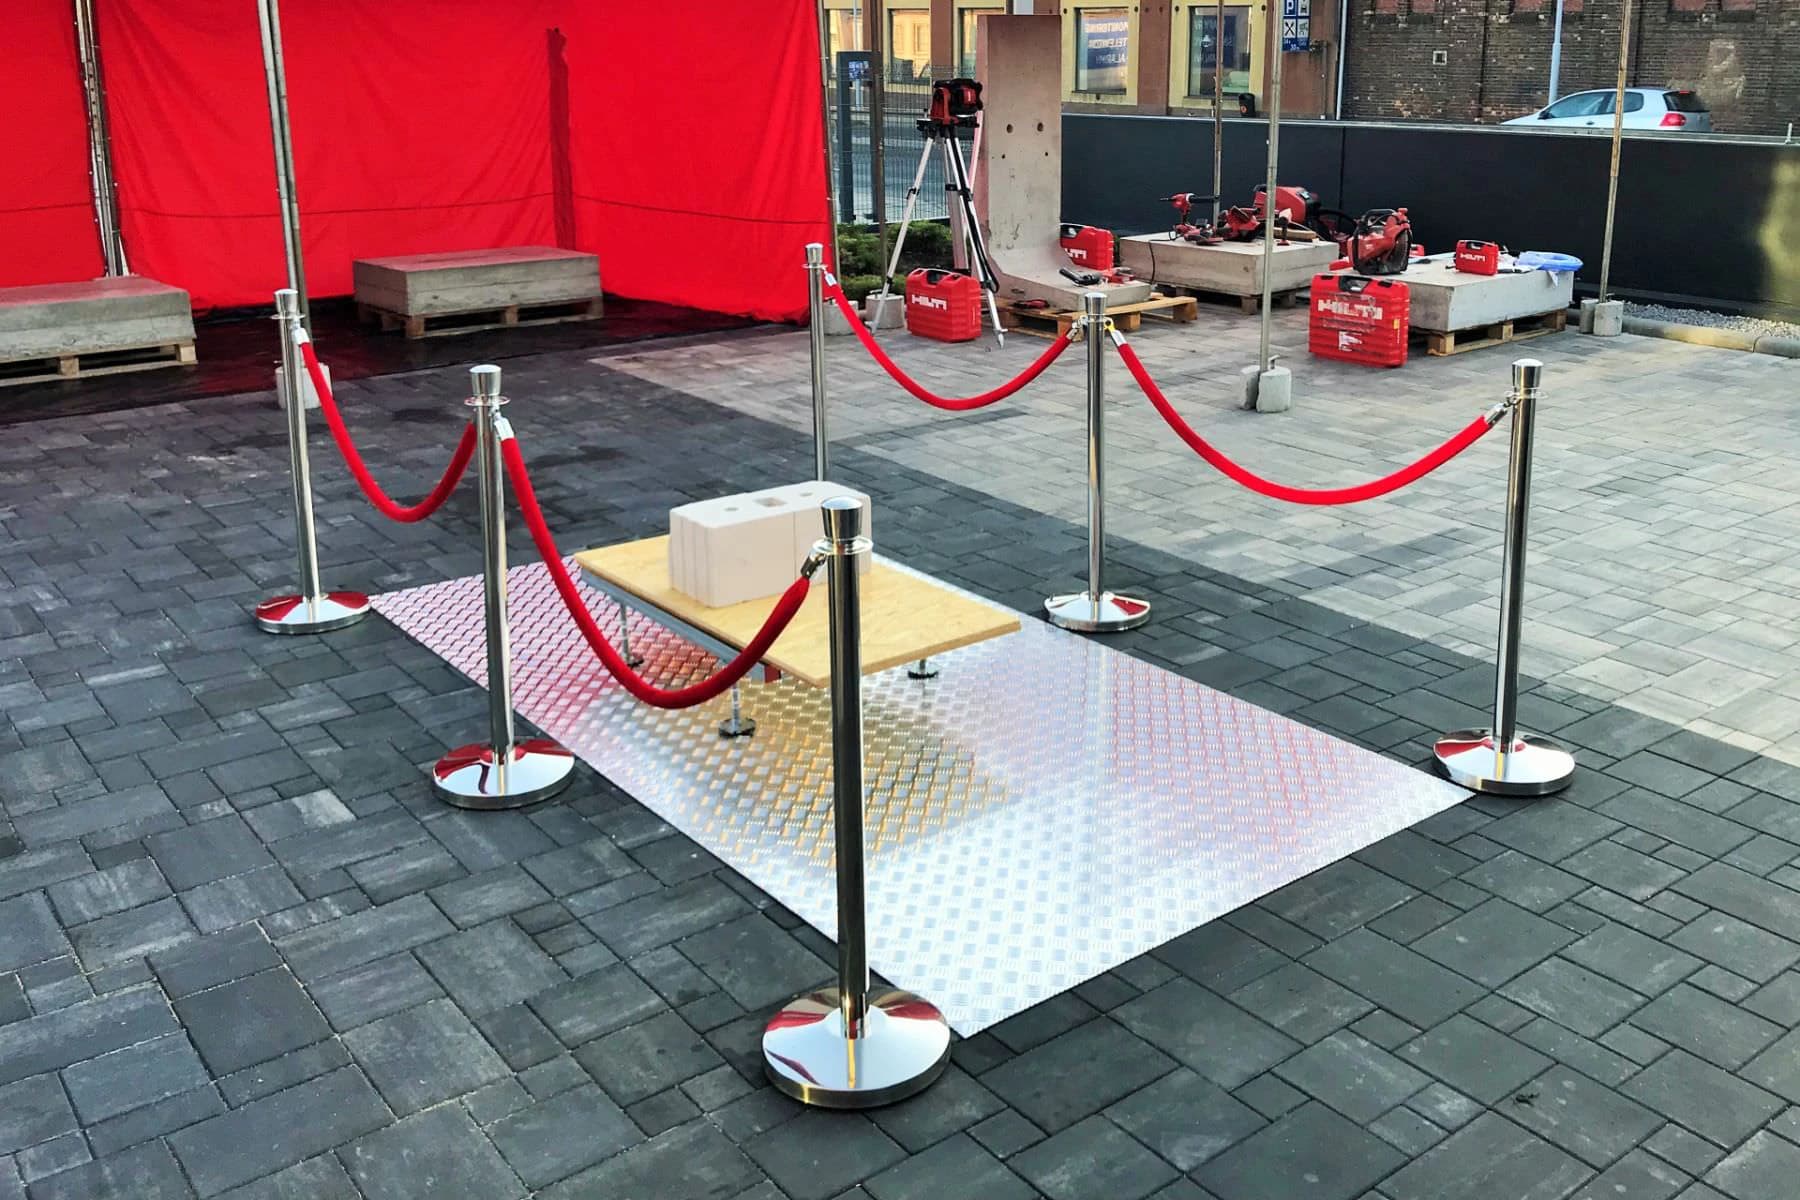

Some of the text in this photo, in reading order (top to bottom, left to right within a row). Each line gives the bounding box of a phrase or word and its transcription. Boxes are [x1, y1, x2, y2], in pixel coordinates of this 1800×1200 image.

[1286, 0, 1294, 14] P
[1460, 253, 1486, 262] HILTI
[911, 294, 947, 311] HILTI
[1317, 299, 1383, 320] HILTI
